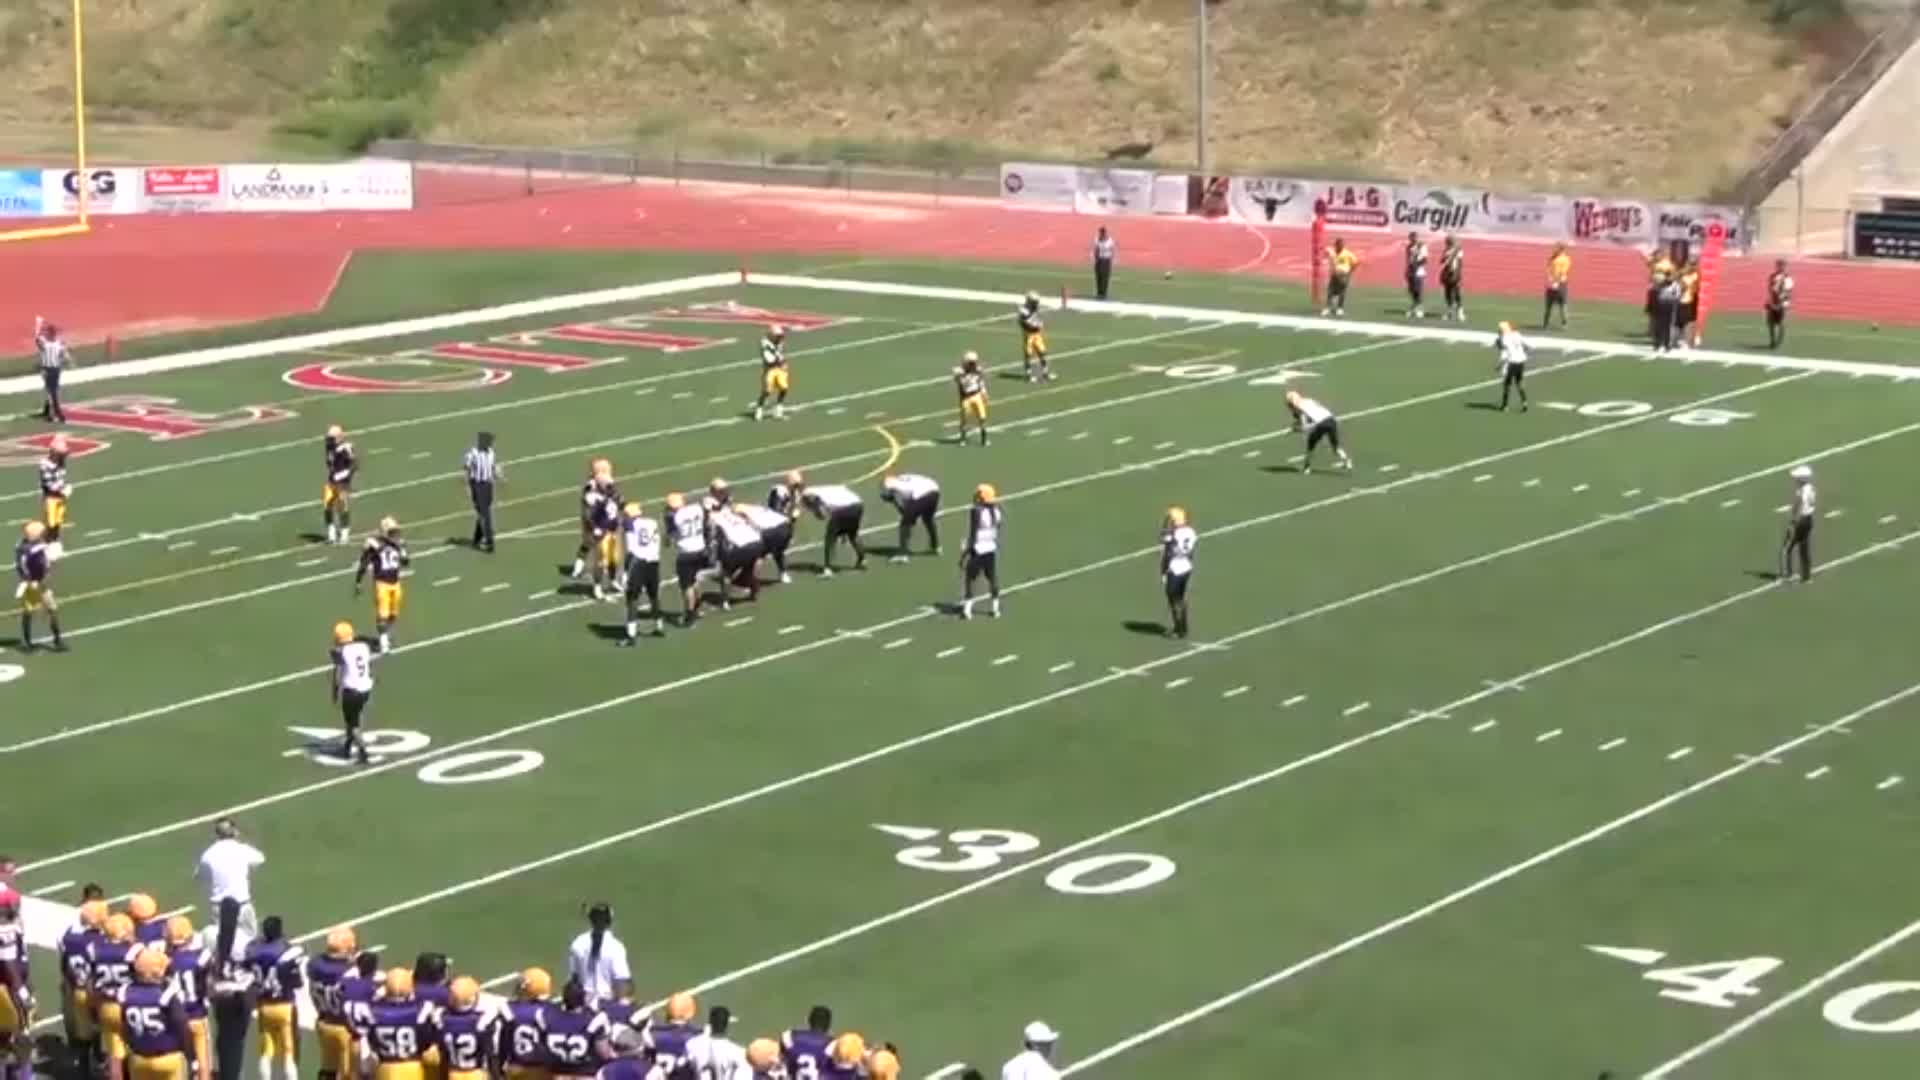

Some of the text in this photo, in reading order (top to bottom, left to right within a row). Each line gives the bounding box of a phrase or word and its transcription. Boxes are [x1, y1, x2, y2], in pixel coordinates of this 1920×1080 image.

[1394, 200, 1470, 231] Cargill
[282, 301, 864, 393] CITY
[895, 828, 1176, 894] 30
[126, 1007, 165, 1036] 95
[375, 1026, 418, 1060] 58
[444, 1032, 477, 1069] 12
[546, 1033, 589, 1062] 52
